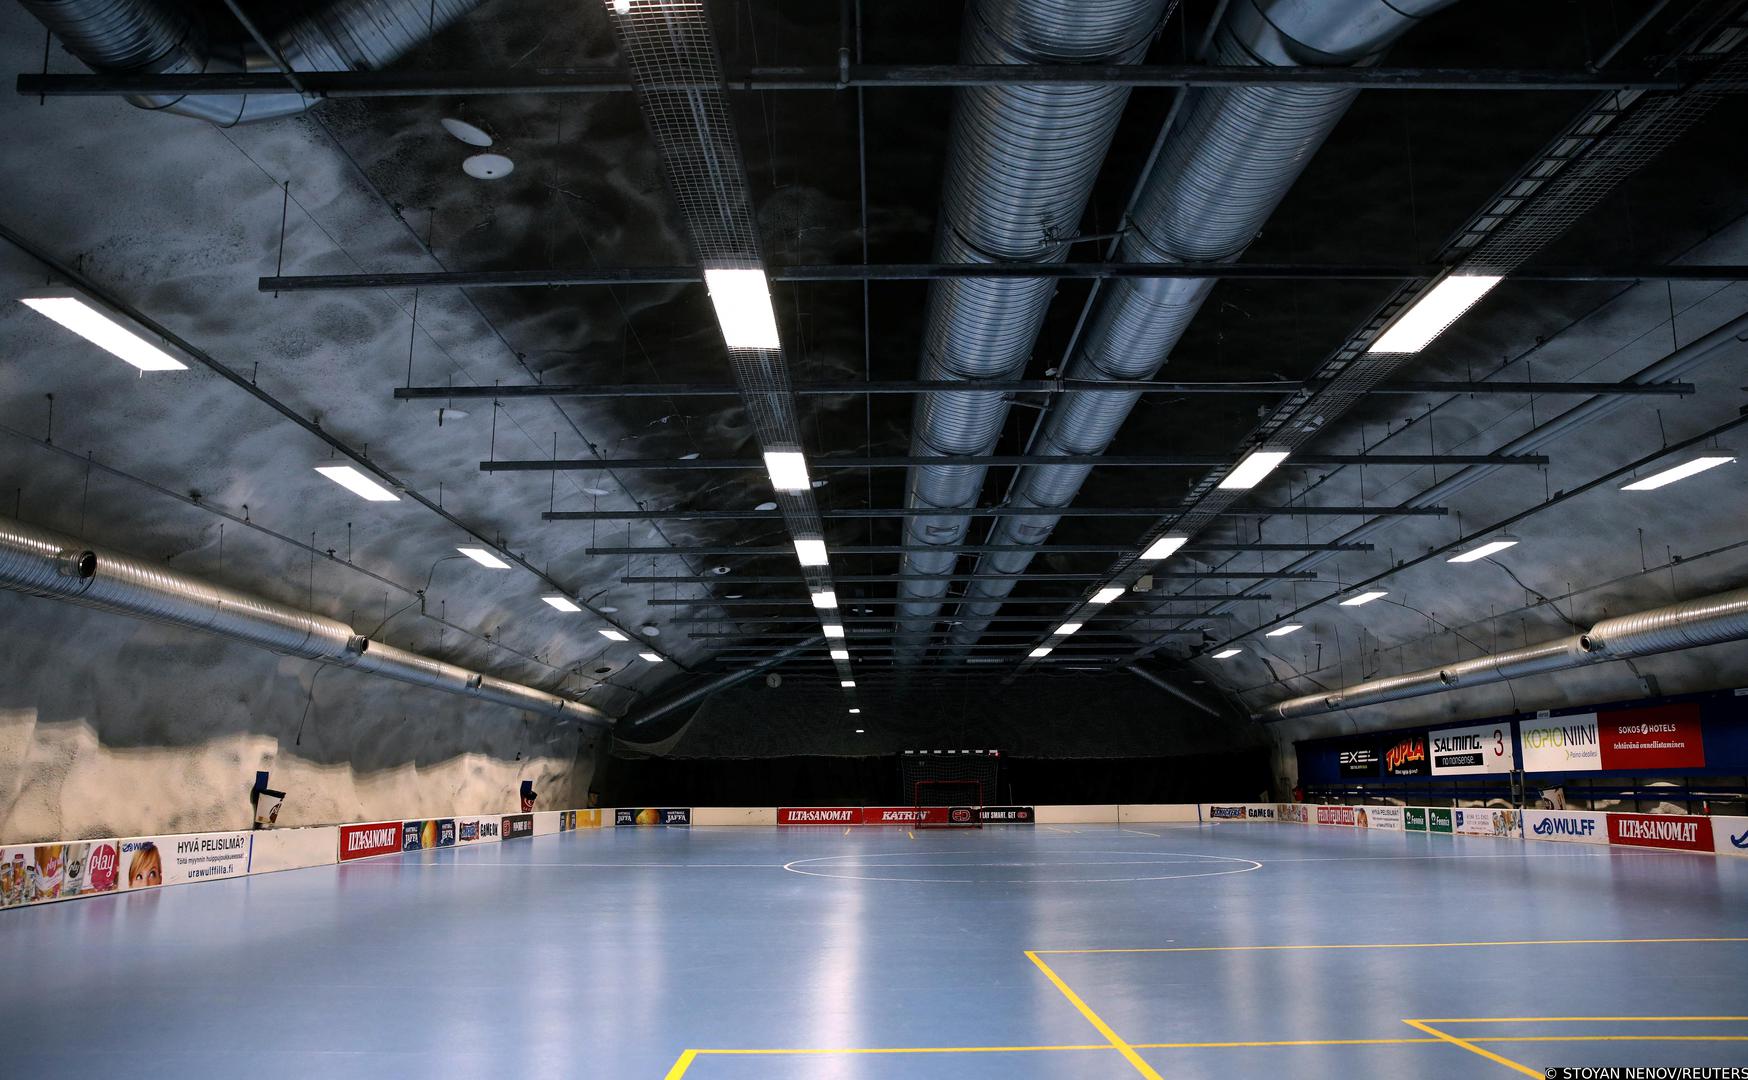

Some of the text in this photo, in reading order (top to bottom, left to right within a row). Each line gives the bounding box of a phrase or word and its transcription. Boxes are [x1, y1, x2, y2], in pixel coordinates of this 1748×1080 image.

[1523, 724, 1597, 749] KOPIONIINI
[1618, 724, 1676, 734] SOKOS HOTELS
[1493, 729, 1504, 756] 3
[1340, 750, 1378, 764] EXEL
[1386, 738, 1425, 771] TUPLA
[617, 815, 632, 824] JAFFA
[666, 814, 687, 824] JAFFA
[788, 810, 853, 821] ILTA-SANOMAT
[882, 811, 927, 821] KATRIN
[1553, 818, 1595, 836] WULFF
[1619, 819, 1698, 842] ILTA-SANOMAT
[177, 836, 245, 854] HYVÄ PELISILMÄ?
[348, 828, 397, 851] ILTA-SANOMAT
[90, 845, 116, 877] play
